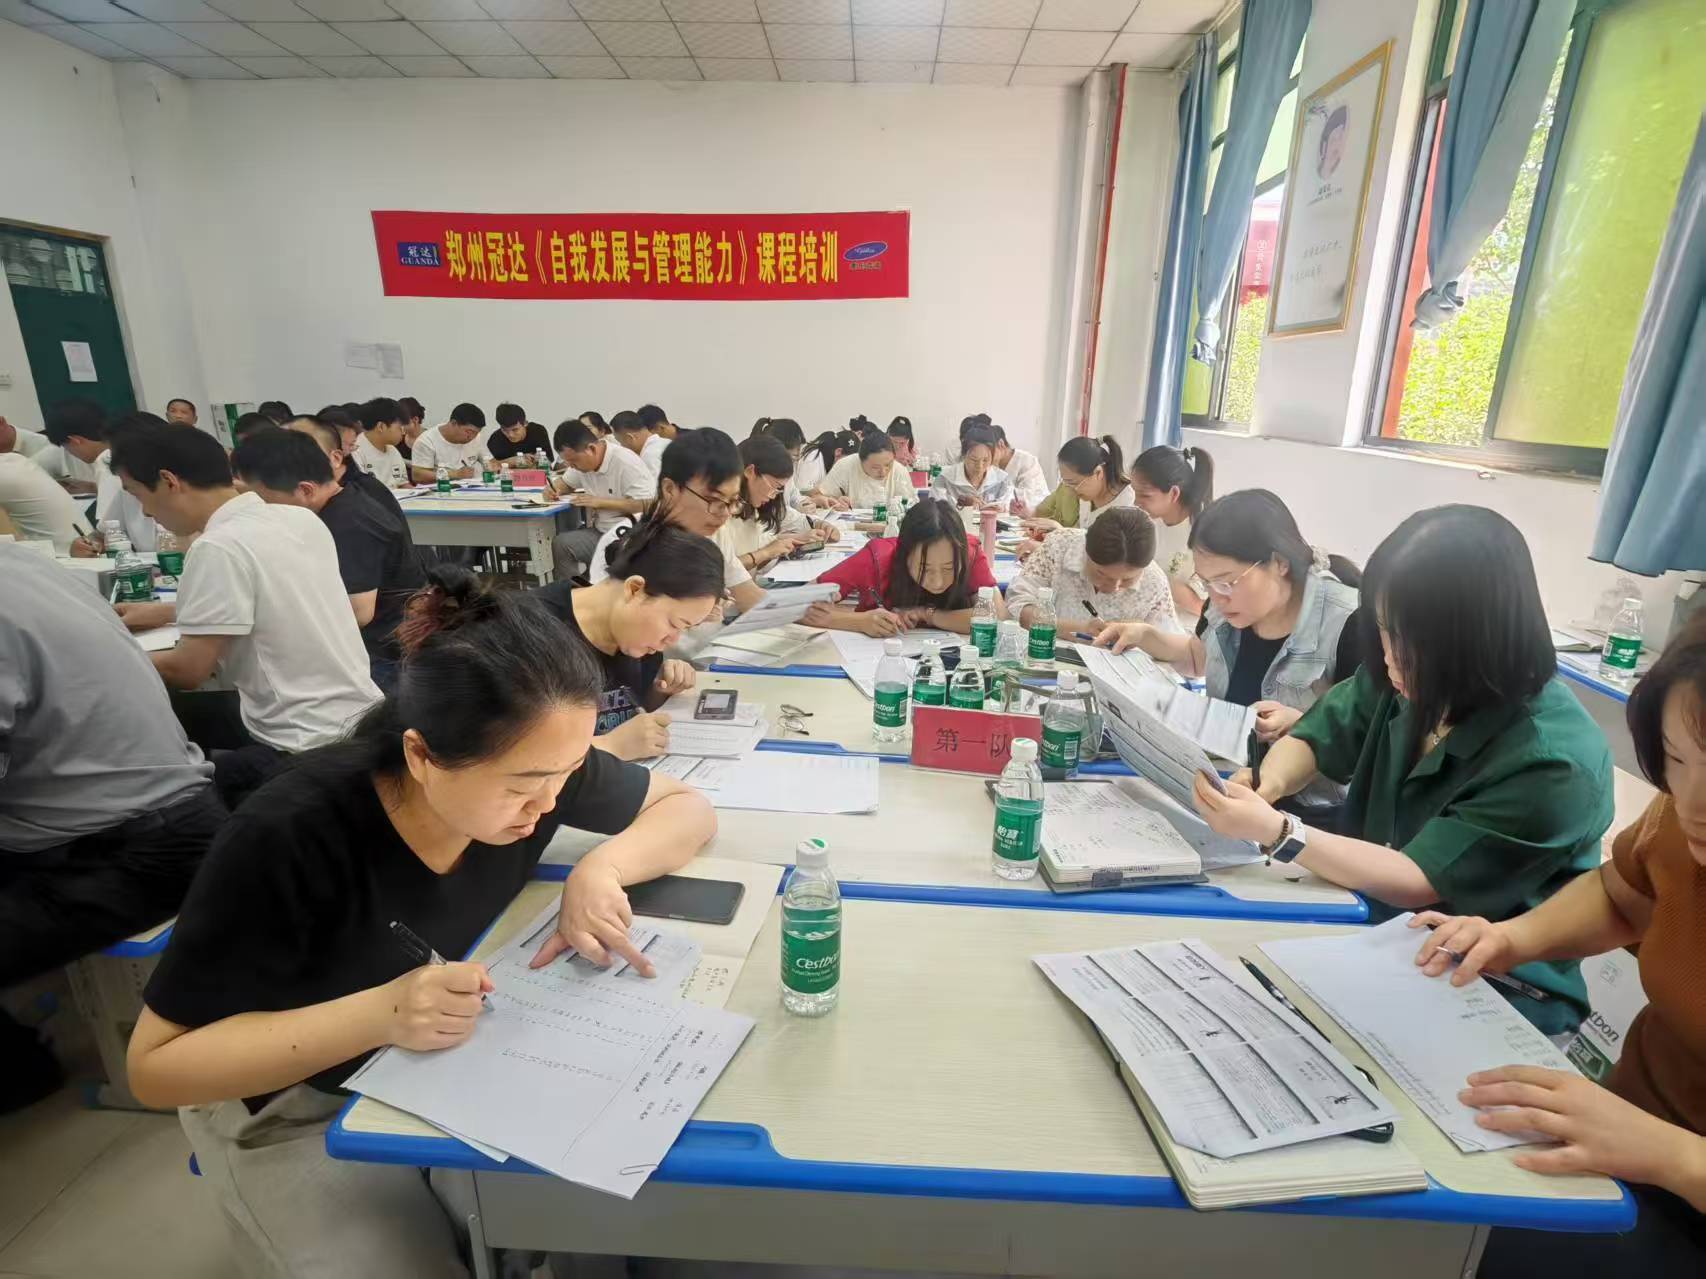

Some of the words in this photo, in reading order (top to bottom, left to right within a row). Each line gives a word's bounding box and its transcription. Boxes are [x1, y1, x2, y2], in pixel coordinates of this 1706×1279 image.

[407, 245, 433, 258] 冠达
[401, 257, 440, 266] GUANDA
[932, 727, 1012, 759] 第一队
